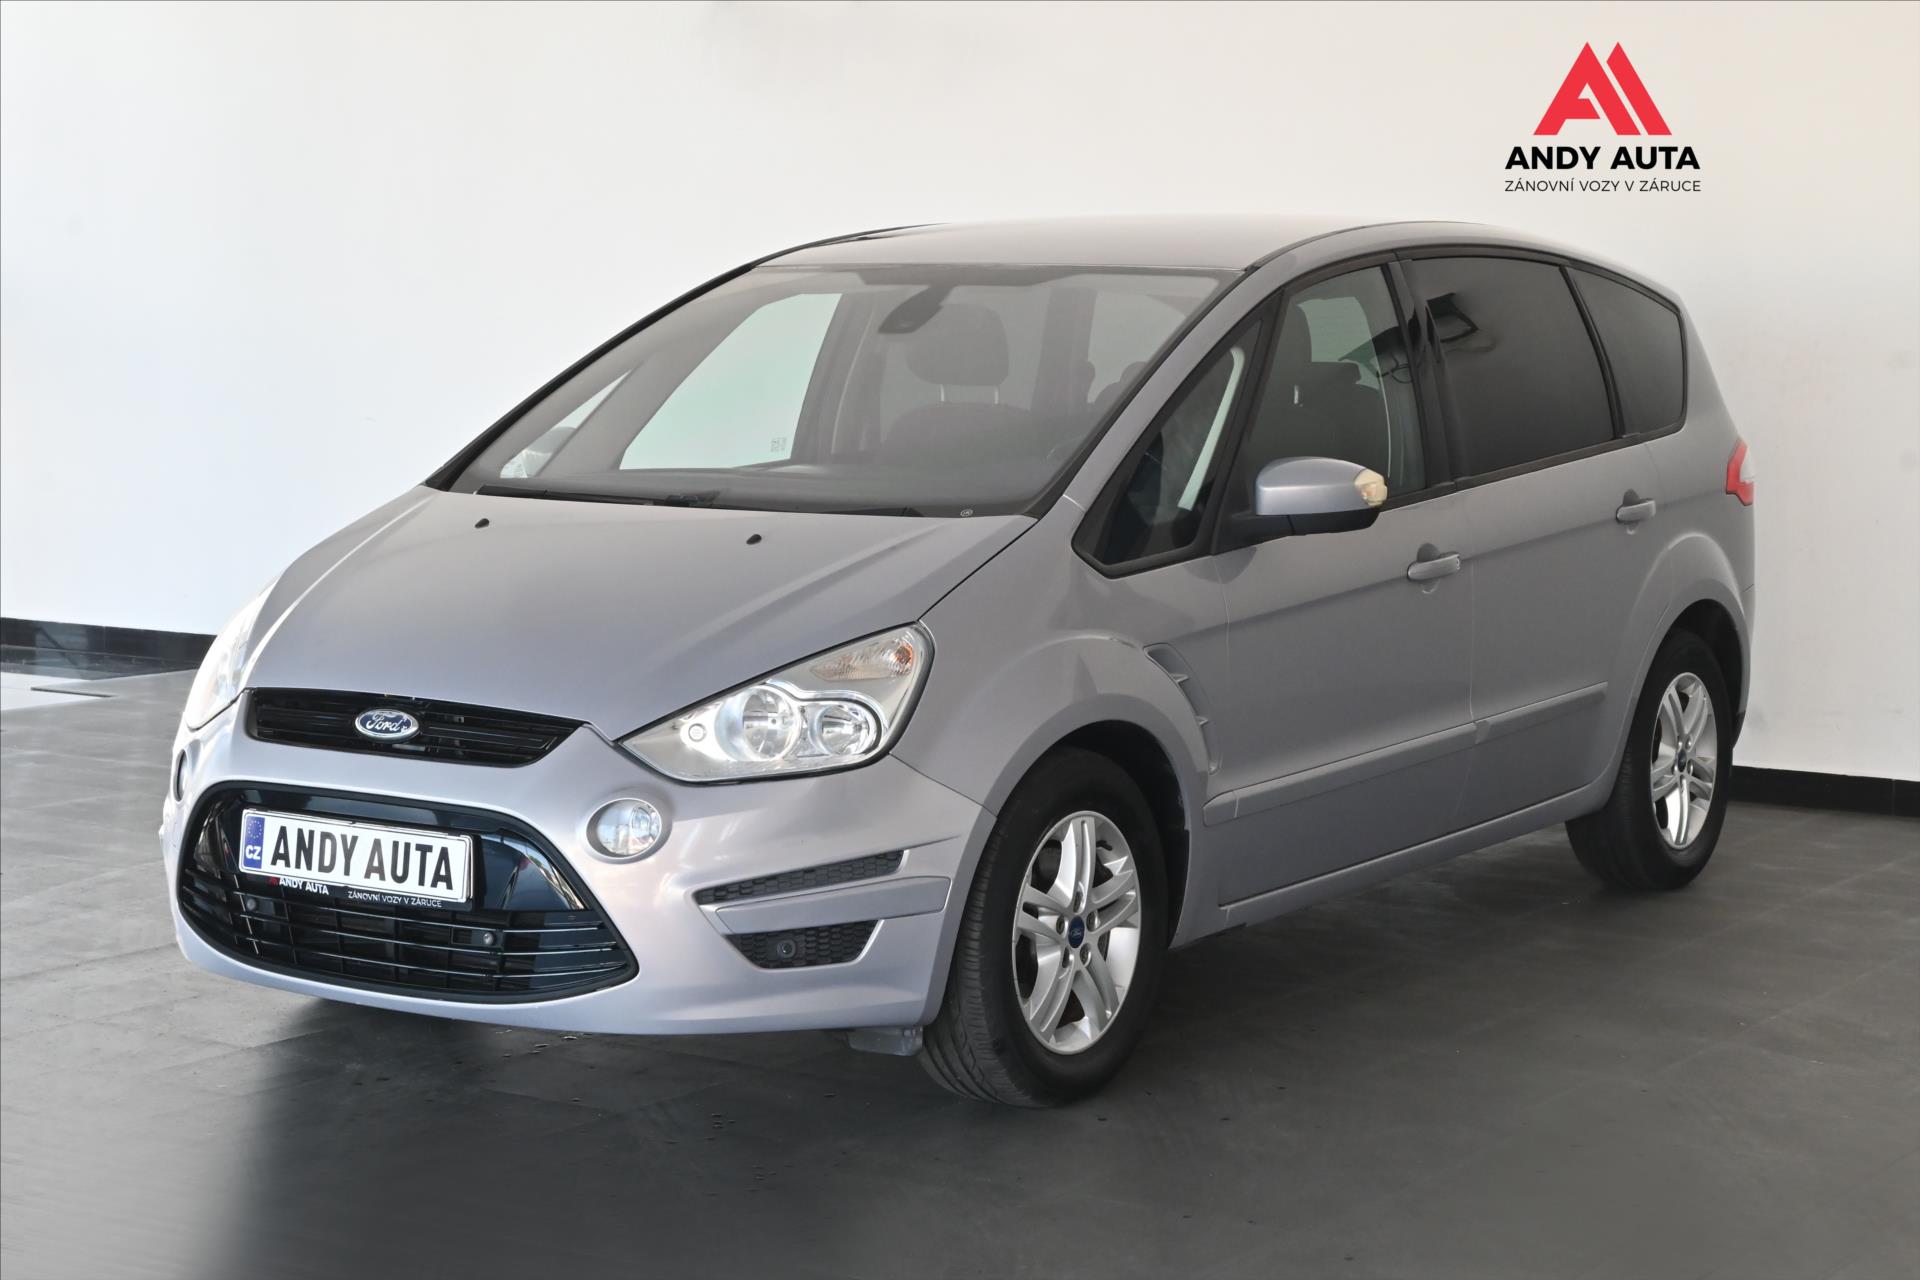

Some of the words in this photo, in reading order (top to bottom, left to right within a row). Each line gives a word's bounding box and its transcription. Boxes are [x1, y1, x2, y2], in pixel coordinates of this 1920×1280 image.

[366, 713, 408, 732] Ford
[245, 844, 262, 860] CZ
[270, 825, 358, 877] ANDY
[364, 838, 454, 891] AUTA
[279, 877, 304, 890] ANDY
[305, 882, 330, 895] AUTA
[348, 890, 381, 902] ZÁNOVNÍ
[382, 895, 402, 904] VOZY
[411, 897, 442, 908] ZÁRUCE
